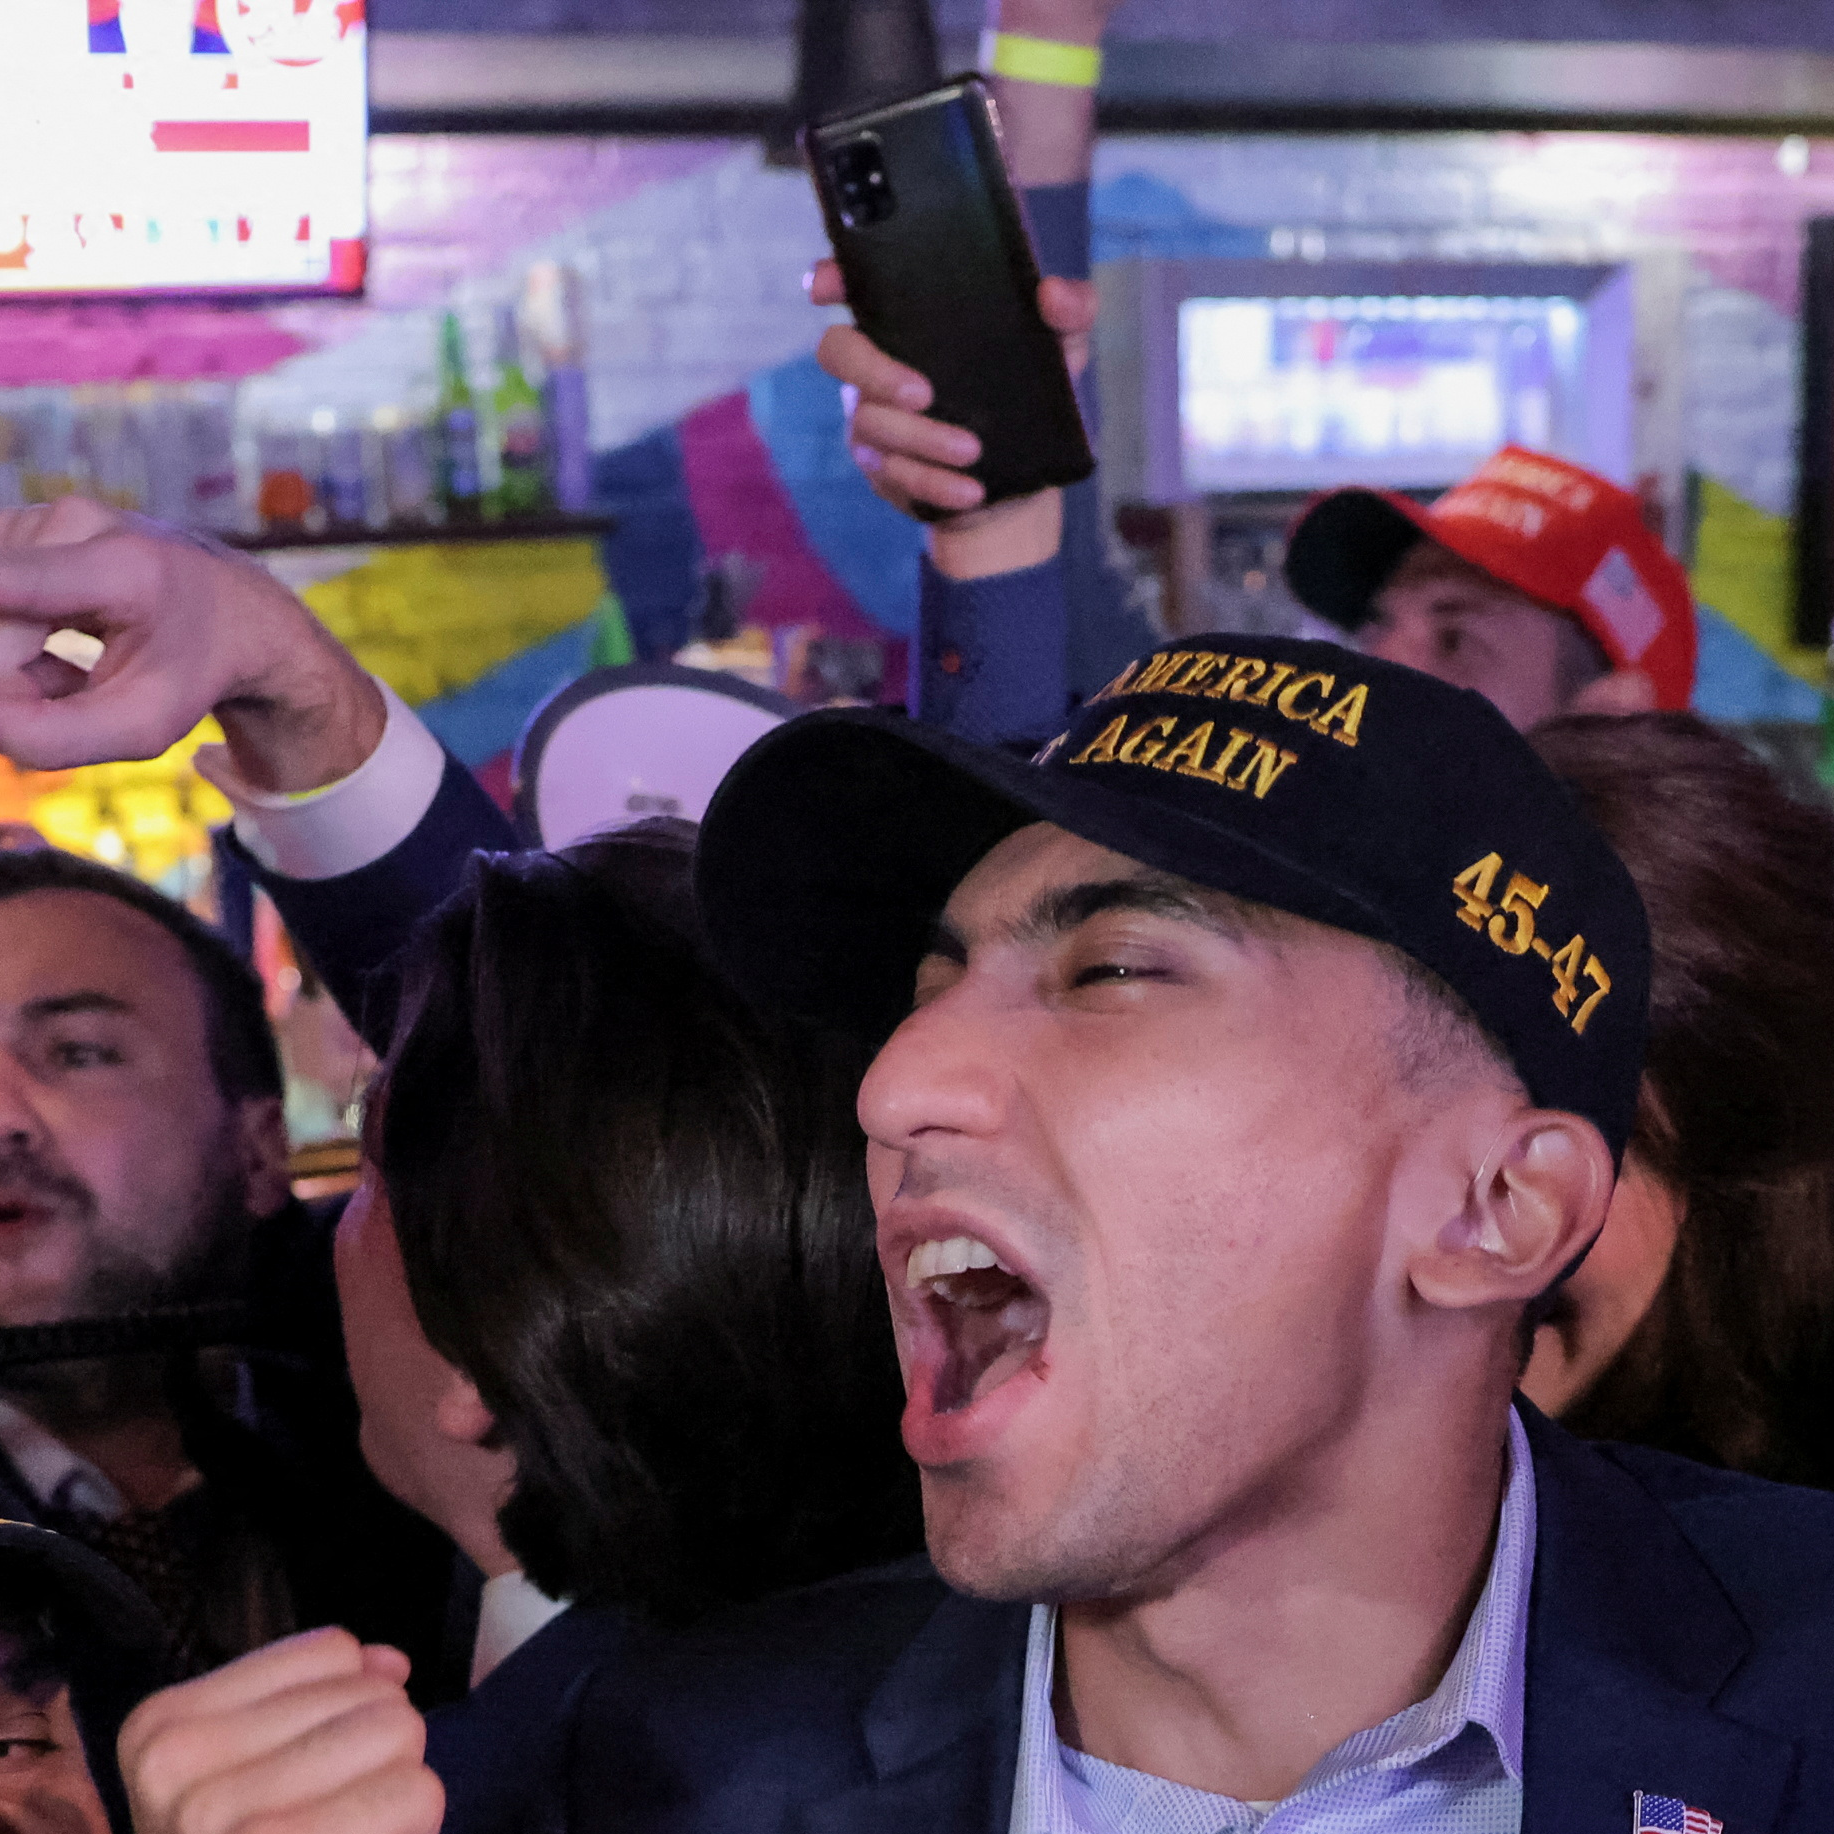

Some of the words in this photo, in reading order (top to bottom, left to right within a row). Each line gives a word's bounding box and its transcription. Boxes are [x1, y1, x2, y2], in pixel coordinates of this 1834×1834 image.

[1083, 650, 1370, 747] AMERICA
[1068, 713, 1299, 799] AGAIN
[1452, 851, 1613, 1035] 45-47
